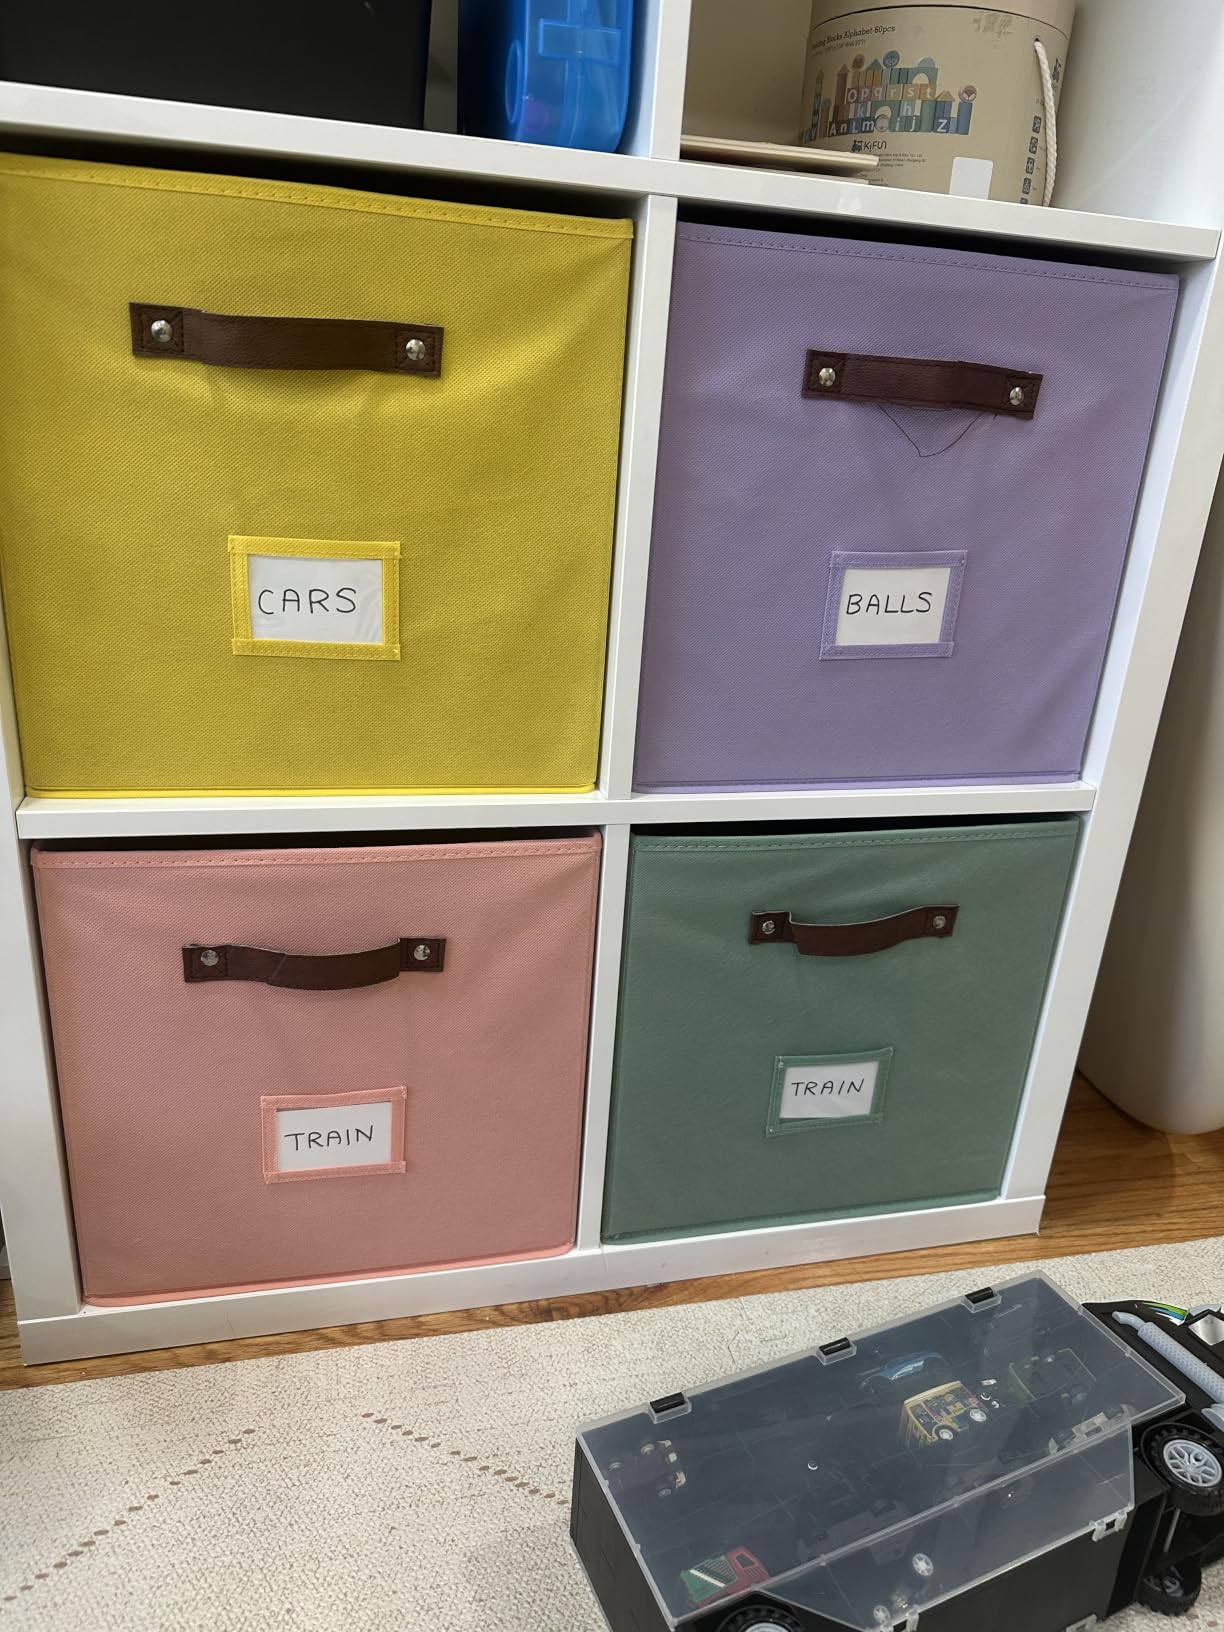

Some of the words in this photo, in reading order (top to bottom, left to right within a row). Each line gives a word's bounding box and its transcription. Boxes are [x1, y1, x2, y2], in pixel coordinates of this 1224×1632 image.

[843, 27, 873, 40] Alphabet
[258, 587, 357, 615] CARS
[846, 591, 933, 615] BALLS
[791, 1078, 865, 1097] TRAIN
[284, 1125, 374, 1151] TRAIN
